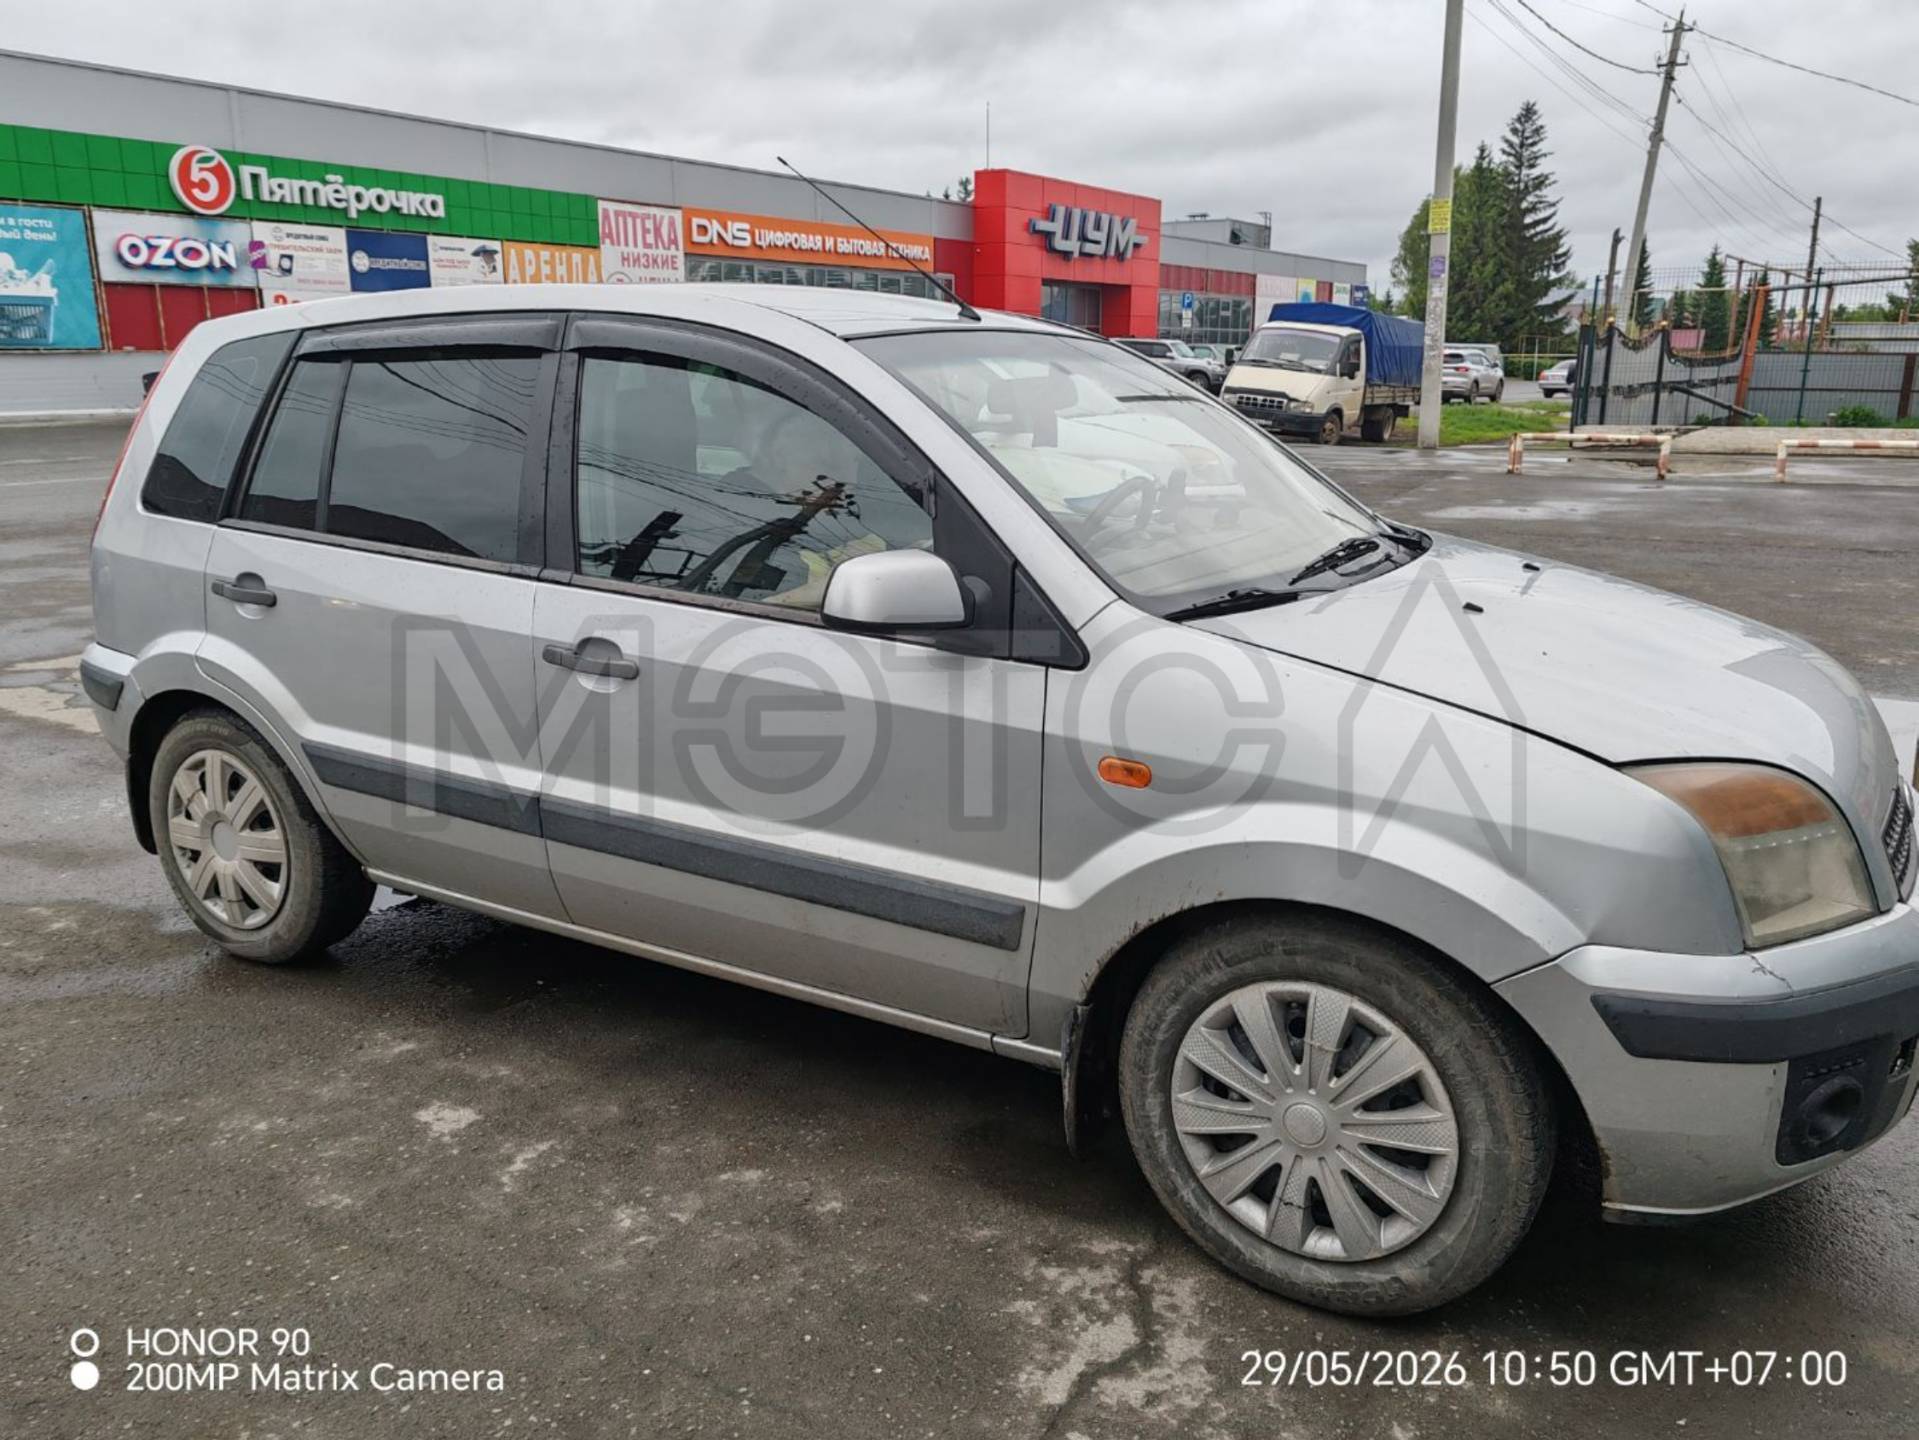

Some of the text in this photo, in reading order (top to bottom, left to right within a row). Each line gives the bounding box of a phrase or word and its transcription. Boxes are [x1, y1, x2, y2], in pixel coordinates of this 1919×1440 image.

[190, 152, 220, 203] 5
[238, 164, 446, 219] Пятёрочка
[601, 207, 681, 251] АПТЕКА
[691, 217, 751, 247] DNS
[755, 228, 931, 262] ЦИФРОВАЯ И БЫТОВАЯ ТЕХНИКА
[1046, 203, 1139, 262] ЦУМ
[116, 233, 238, 272] OZON
[507, 248, 600, 284] АРЕНДА
[620, 251, 679, 271] НИЗКИЕ
